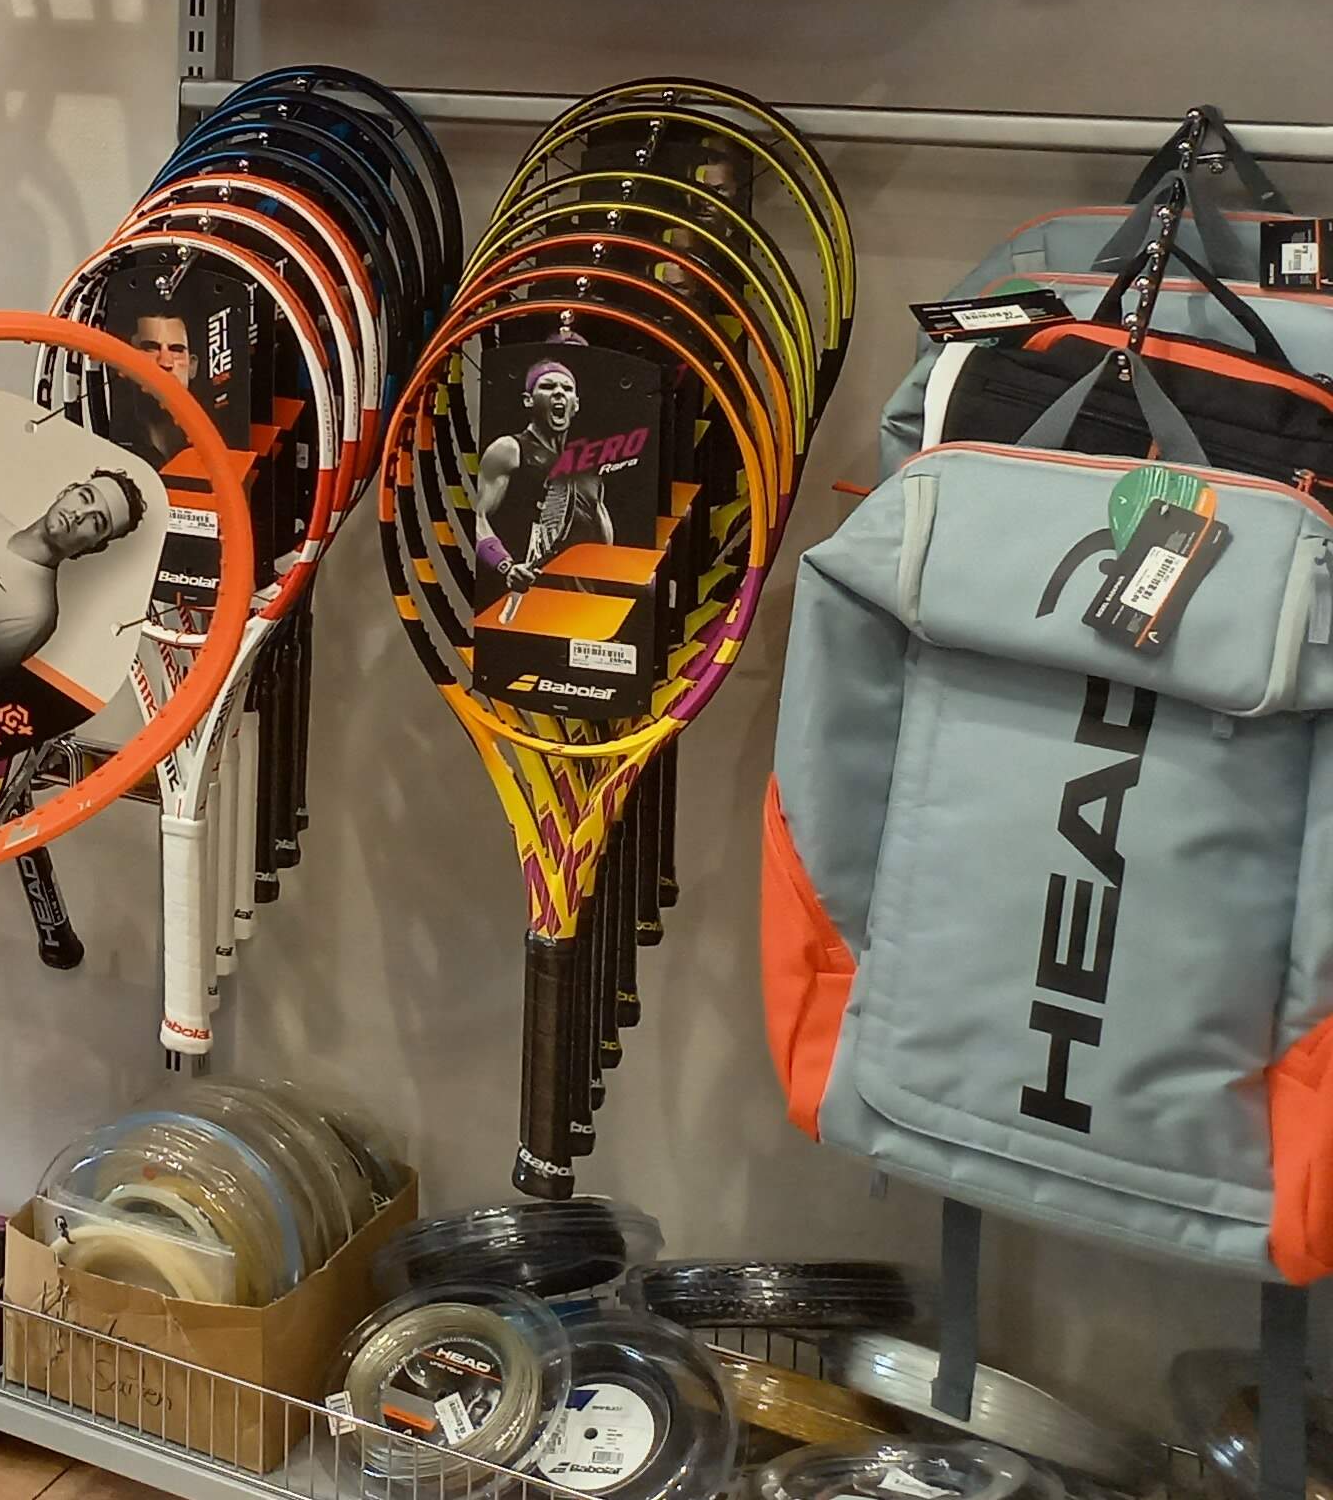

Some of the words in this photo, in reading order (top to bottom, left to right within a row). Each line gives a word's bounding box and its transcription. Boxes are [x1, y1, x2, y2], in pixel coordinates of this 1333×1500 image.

[548, 427, 650, 480] AERO
[537, 678, 618, 701] Babolat
[21, 855, 60, 948] HEAD
[434, 1346, 492, 1375] HEAD
[569, 1462, 624, 1476] Babolat
